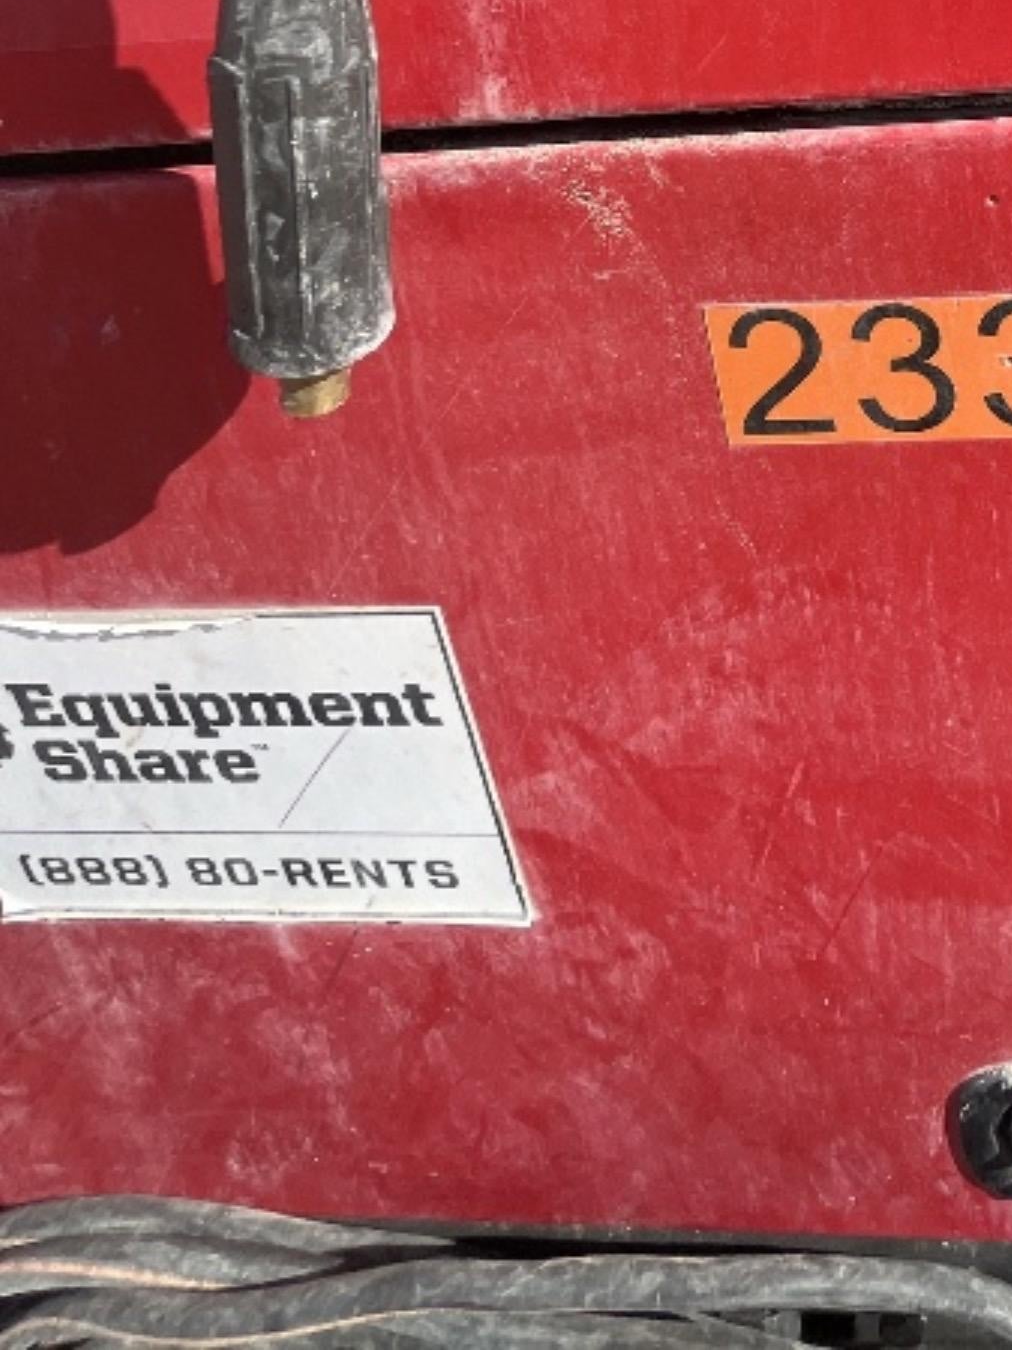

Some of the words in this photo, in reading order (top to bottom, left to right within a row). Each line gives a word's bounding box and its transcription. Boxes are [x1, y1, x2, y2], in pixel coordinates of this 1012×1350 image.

[4, 683, 443, 738] Equipment
[32, 740, 260, 783] Share
[20, 854, 169, 888] (888)
[186, 856, 460, 888] 80-RENTS
